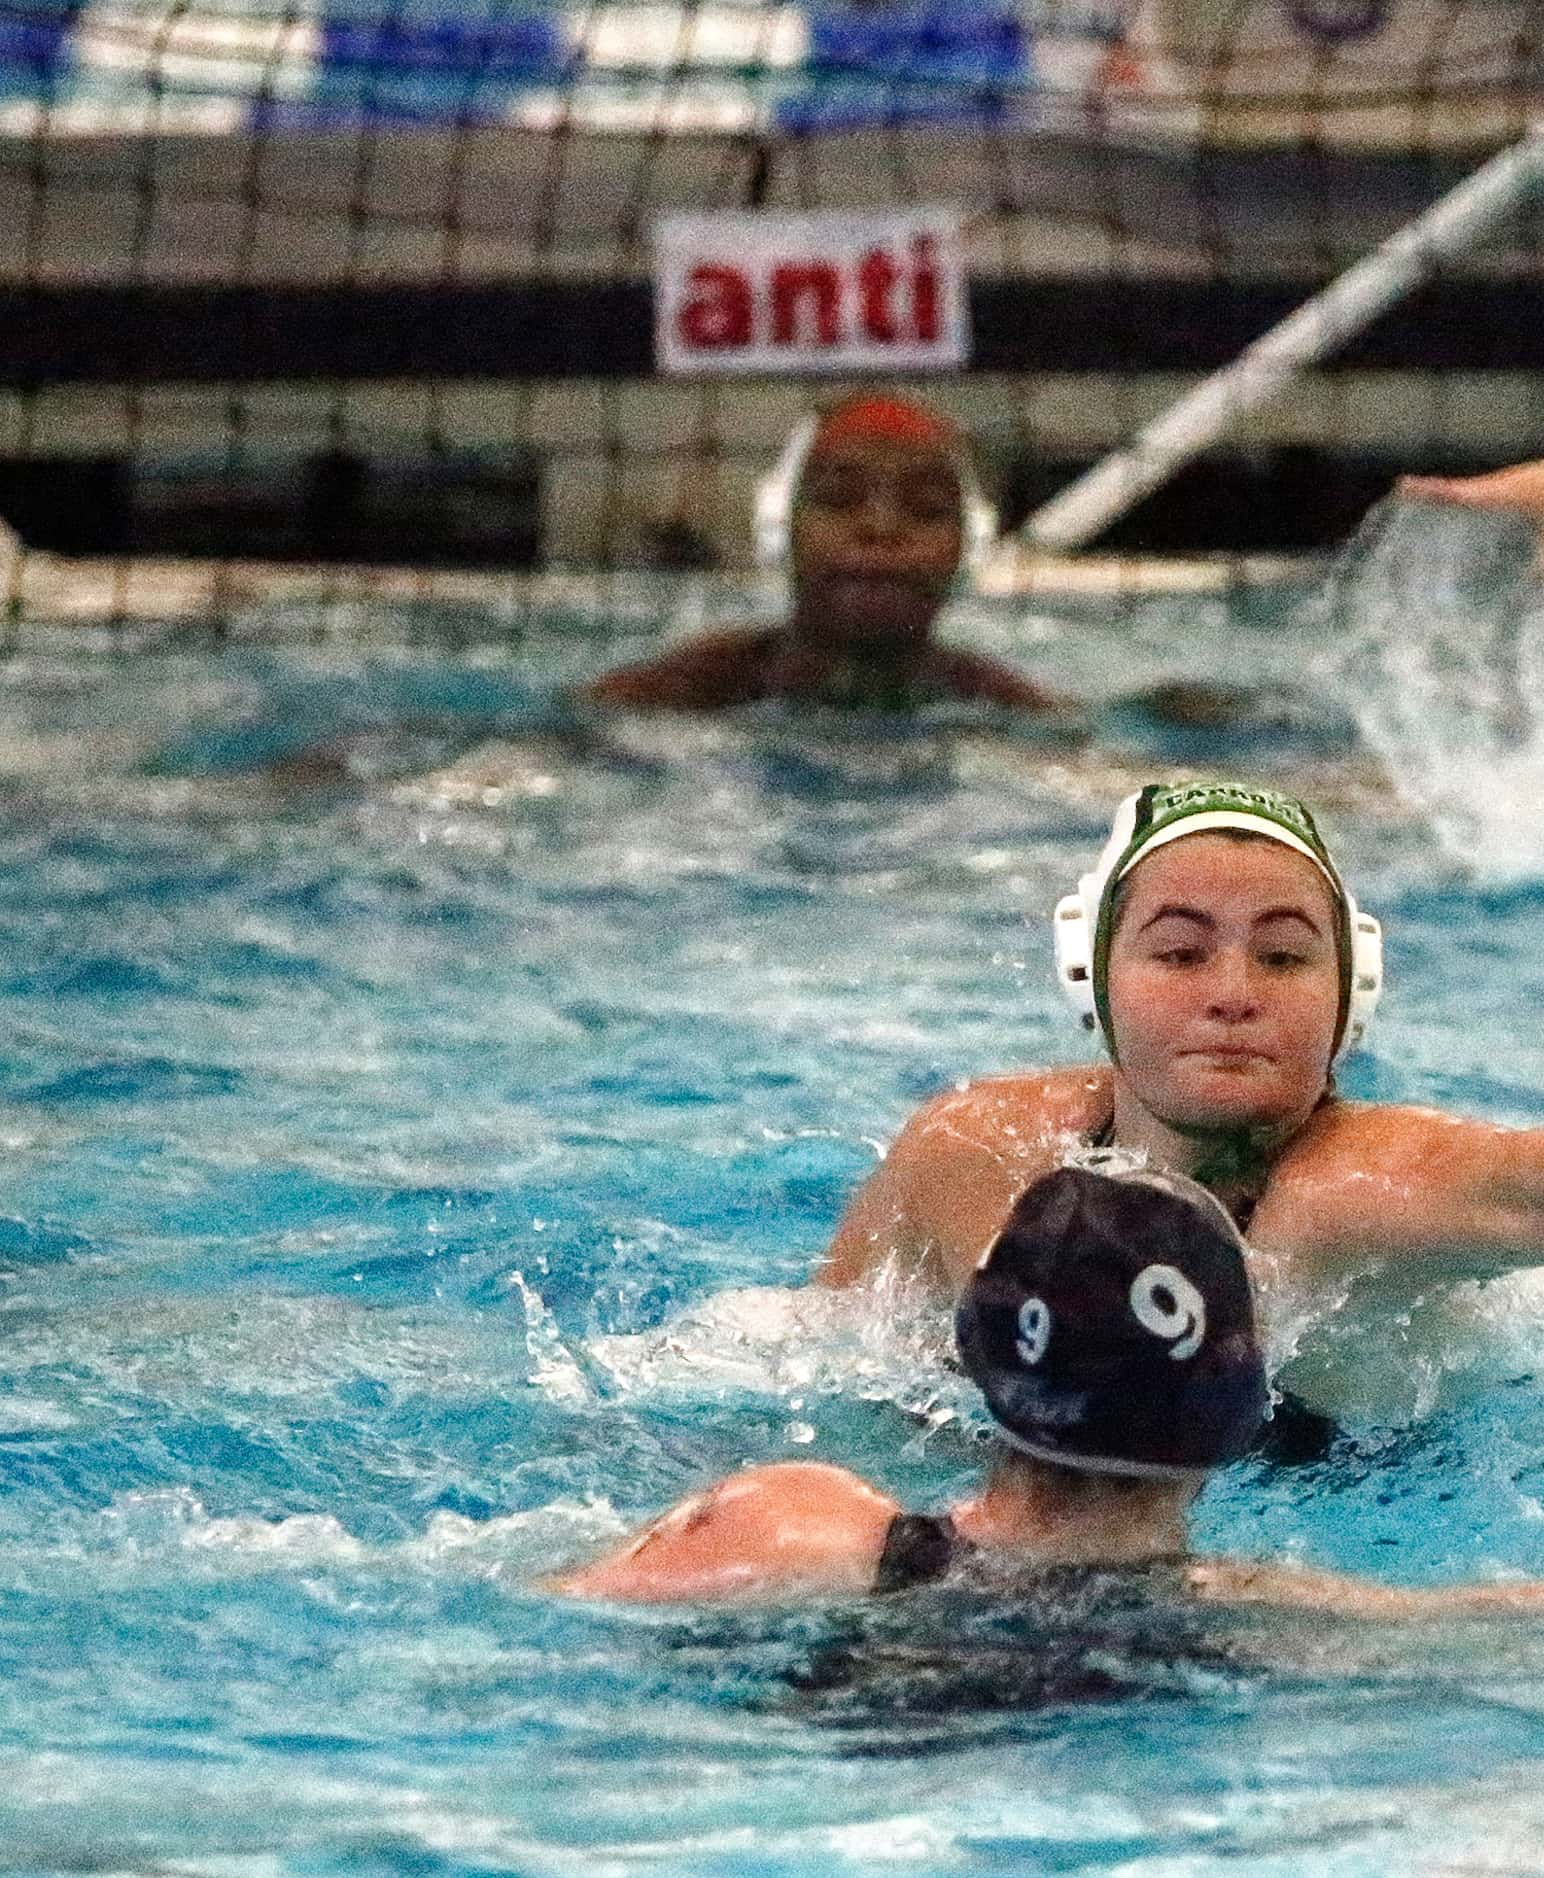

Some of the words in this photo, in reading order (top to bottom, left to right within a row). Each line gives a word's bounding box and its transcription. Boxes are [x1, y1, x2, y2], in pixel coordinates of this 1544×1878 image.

[679, 231, 940, 346] anti
[1016, 1297, 1050, 1365] 9
[1130, 1263, 1207, 1361] 9
